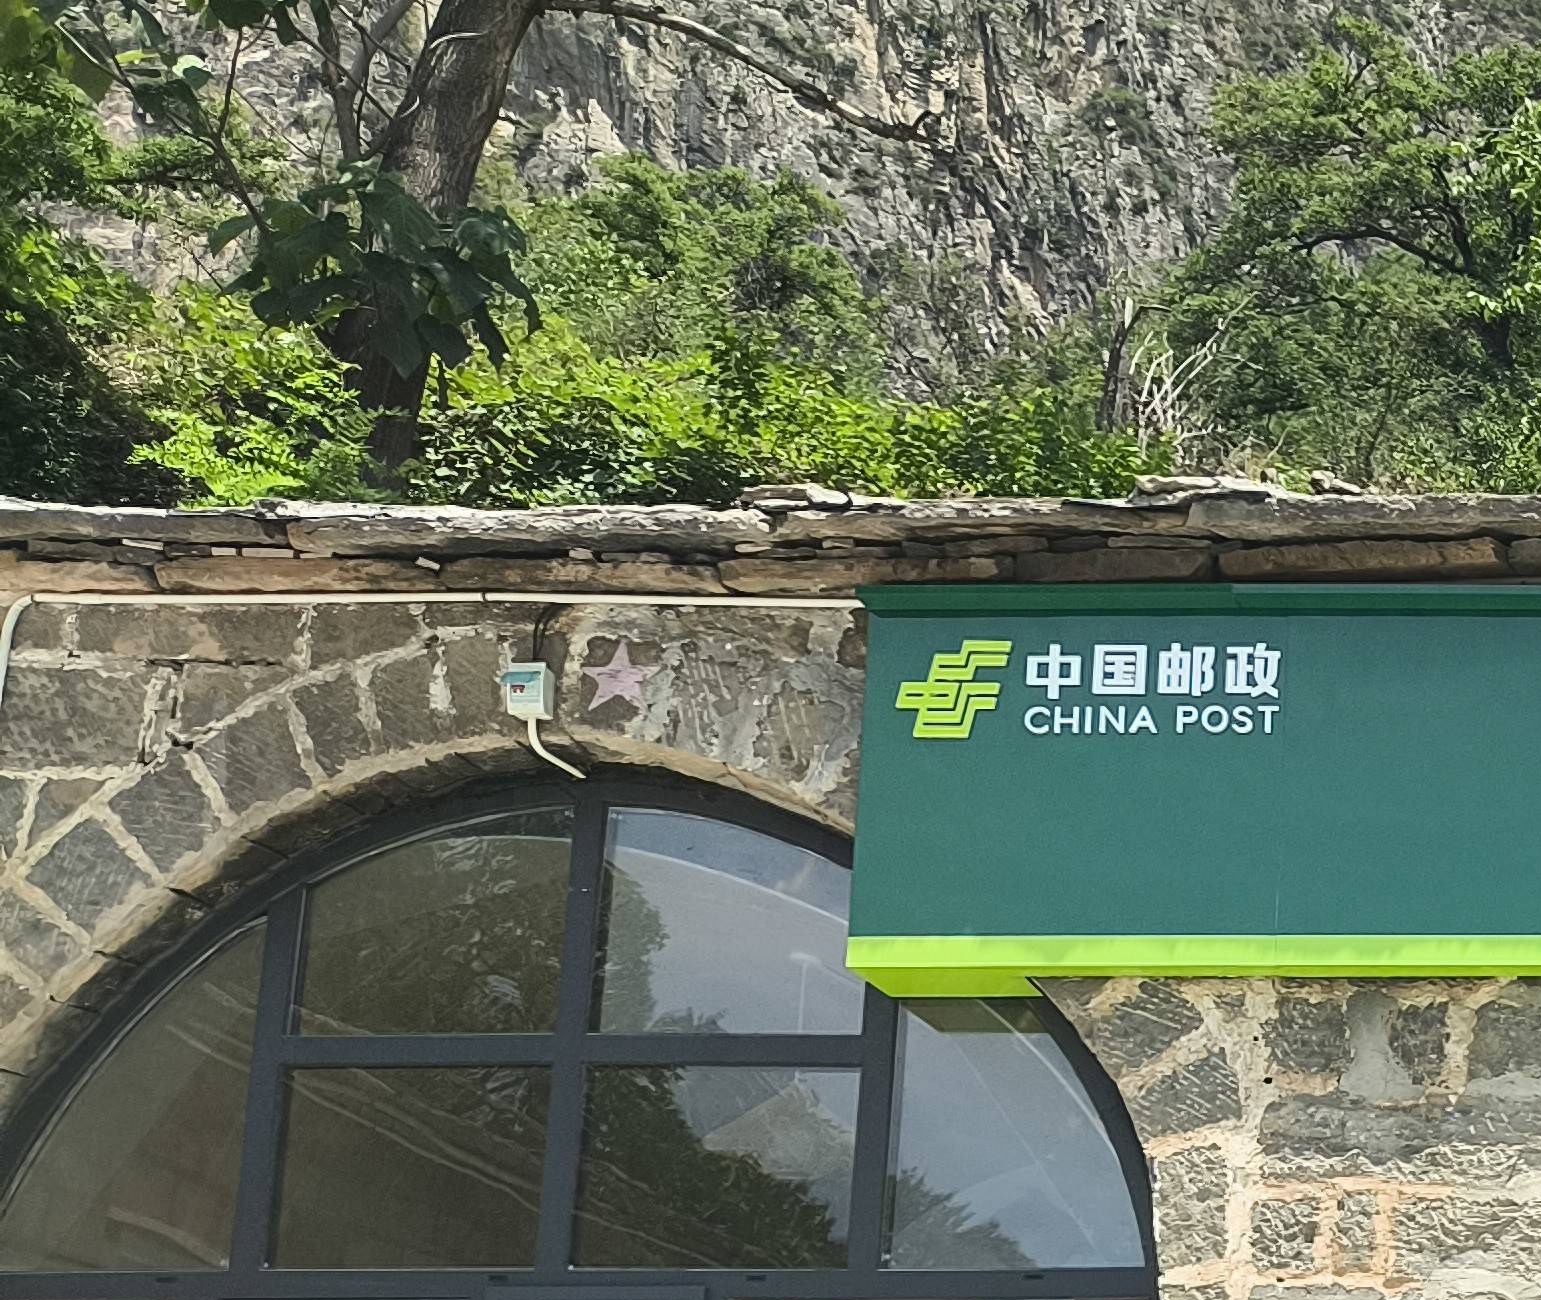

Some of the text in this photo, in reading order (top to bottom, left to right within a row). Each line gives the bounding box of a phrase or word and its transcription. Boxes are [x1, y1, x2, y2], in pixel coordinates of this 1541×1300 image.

[1024, 641, 1282, 701] 中国邮政
[1023, 703, 1281, 736] CHINA POST
